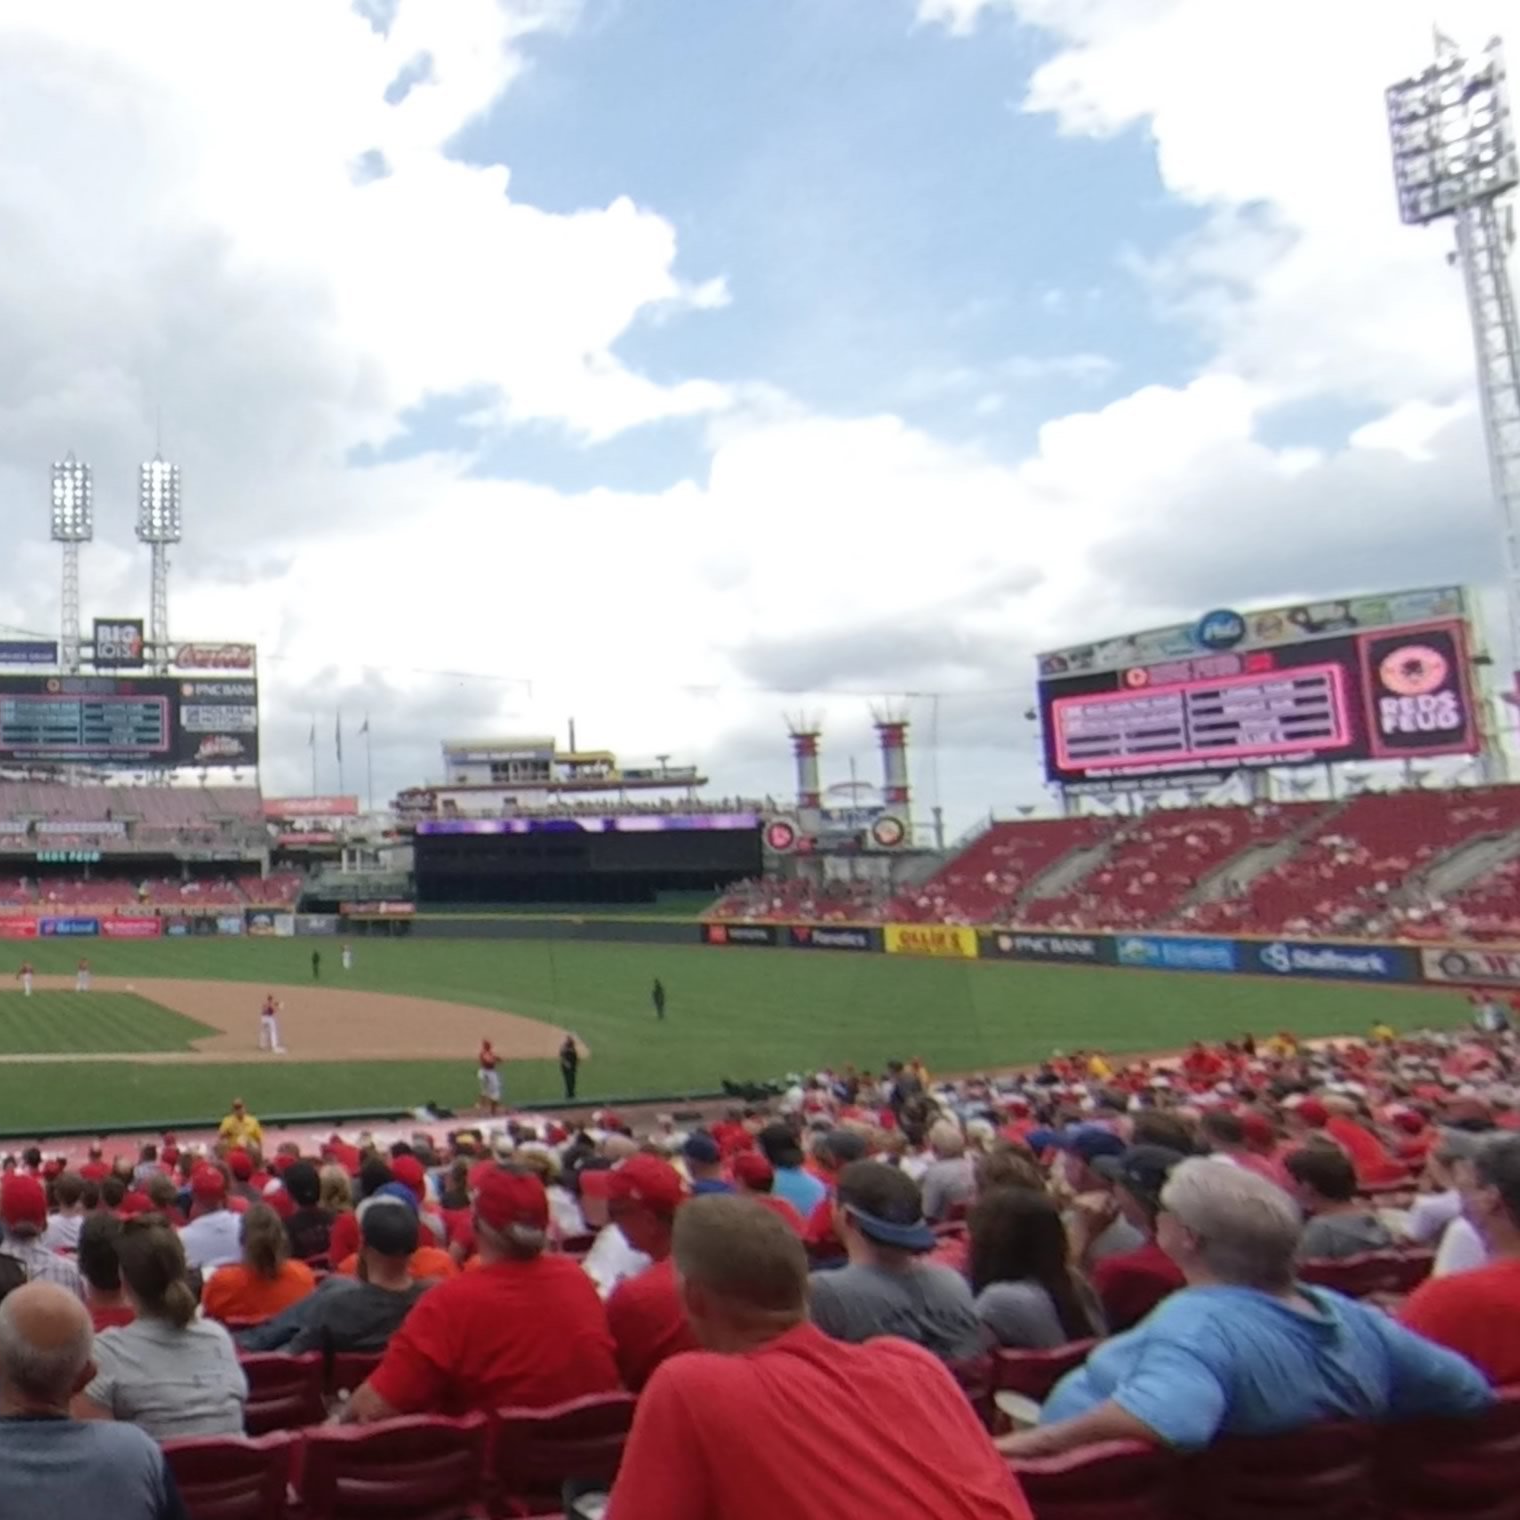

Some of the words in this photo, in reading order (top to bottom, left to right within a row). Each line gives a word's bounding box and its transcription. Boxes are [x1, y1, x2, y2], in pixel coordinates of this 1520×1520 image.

[97, 625, 138, 641] BIG
[1379, 693, 1458, 719] REDS
[1381, 709, 1461, 735] FEUD
[1049, 939, 1097, 956] BANK
